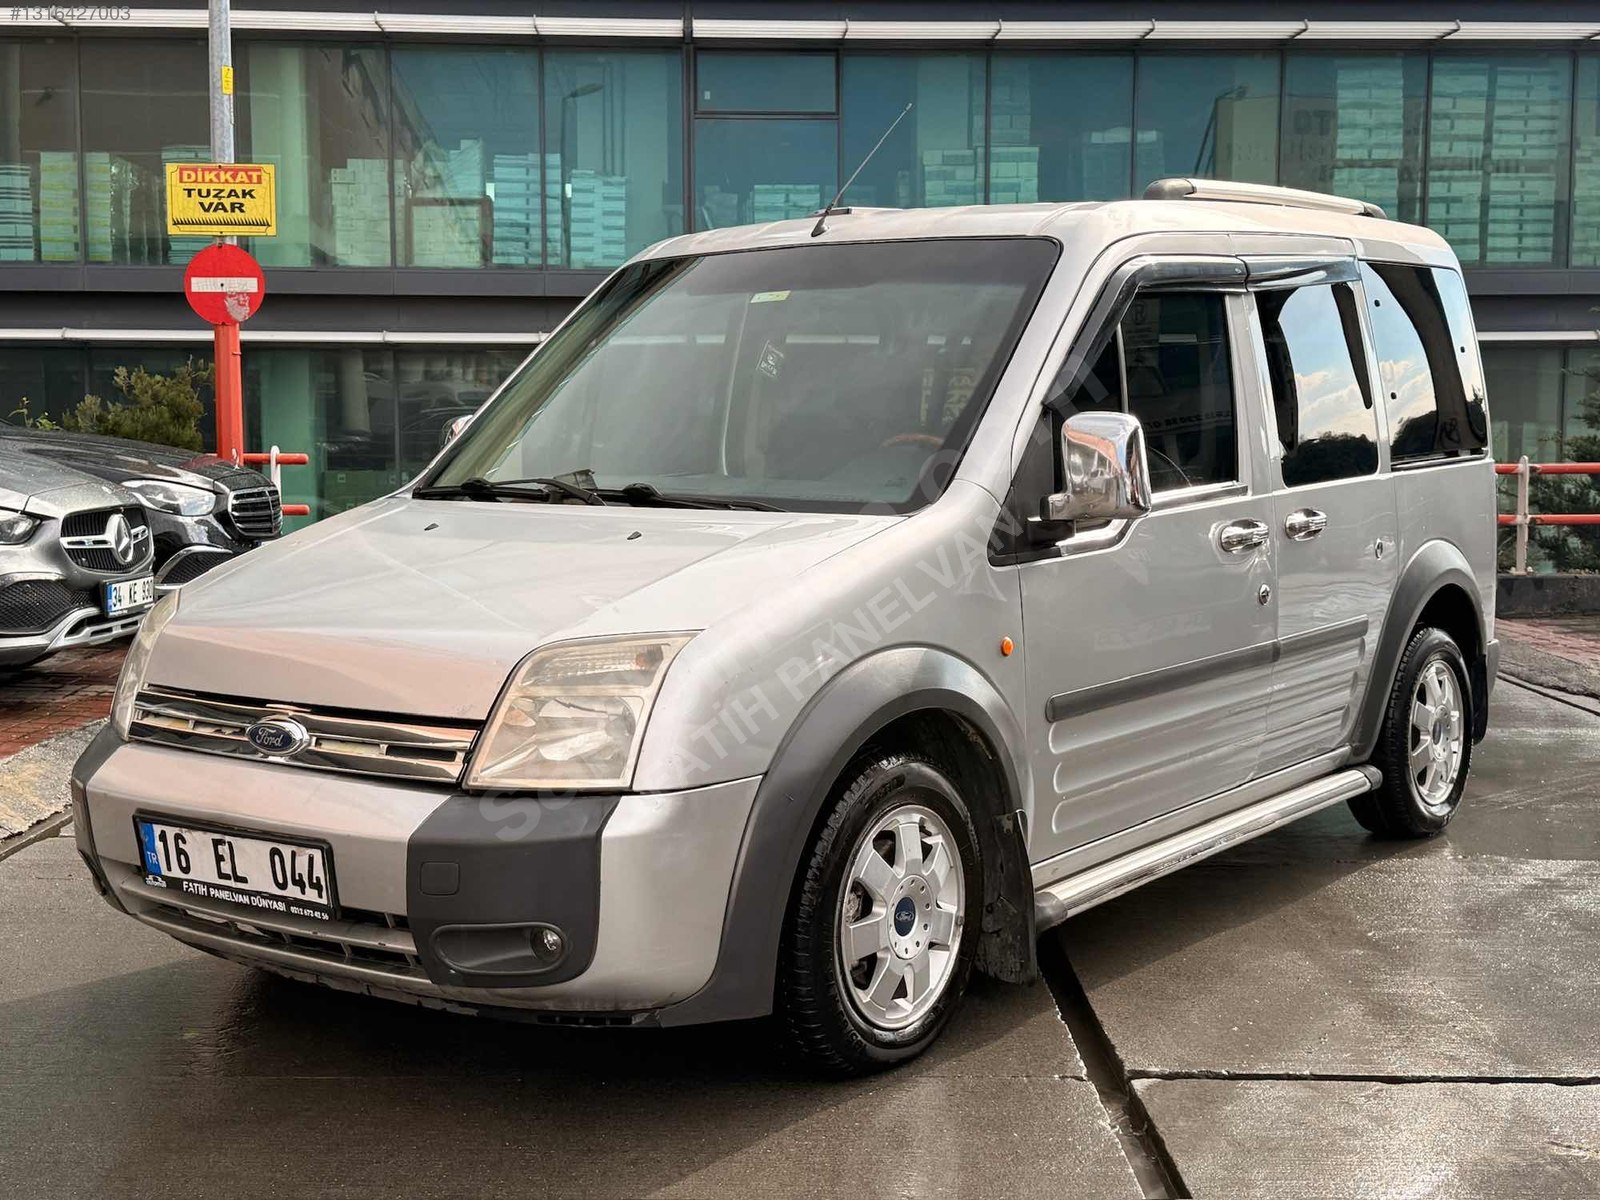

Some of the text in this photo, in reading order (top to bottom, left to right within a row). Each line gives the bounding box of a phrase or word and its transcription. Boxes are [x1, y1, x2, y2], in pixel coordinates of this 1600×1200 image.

[182, 167, 262, 183] DİKKAT
[183, 188, 256, 199] TUZAK
[199, 201, 245, 213] VAR
[255, 726, 283, 747] Ford
[158, 829, 324, 899] 16 EL 044
[209, 887, 250, 905] PANELVAN
[250, 896, 286, 912] DÜNYASI
